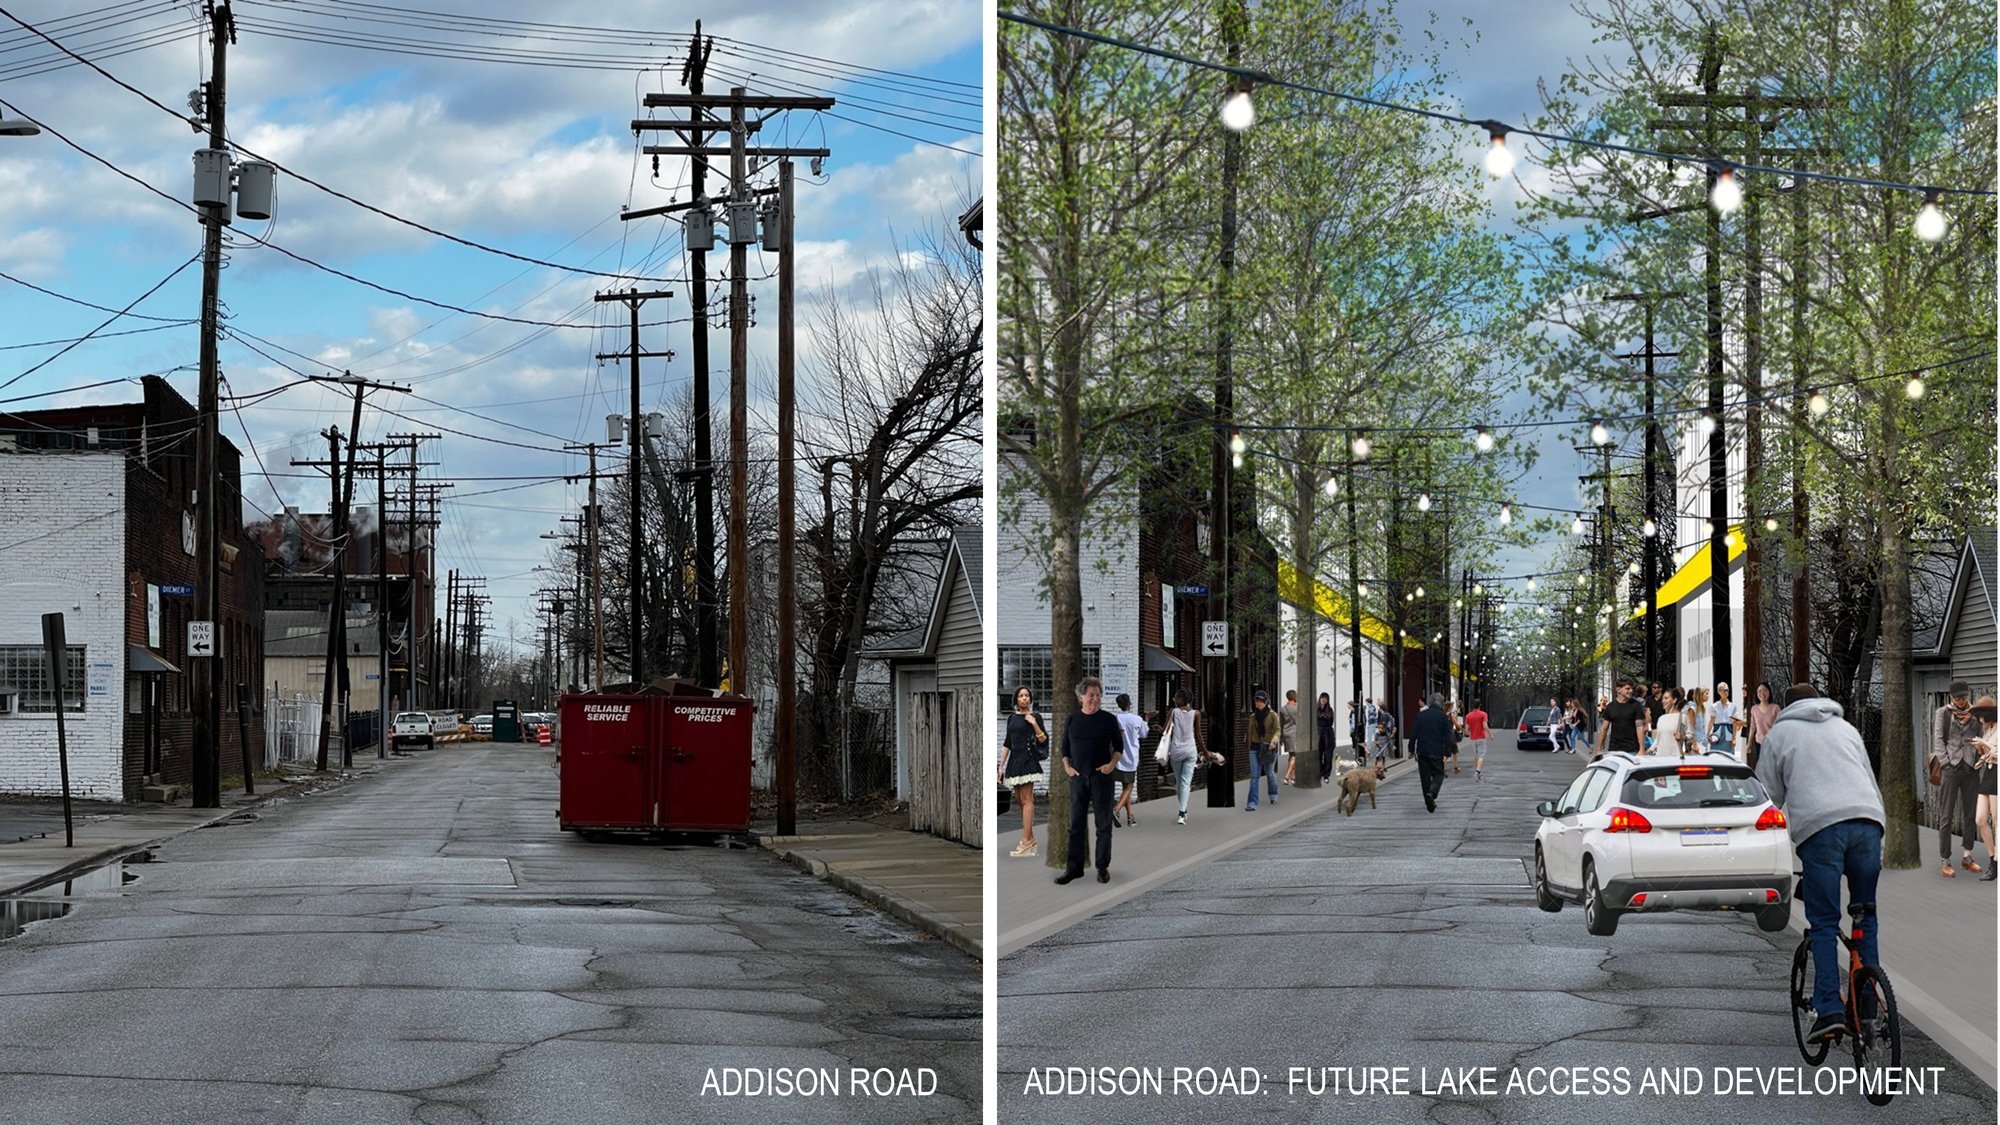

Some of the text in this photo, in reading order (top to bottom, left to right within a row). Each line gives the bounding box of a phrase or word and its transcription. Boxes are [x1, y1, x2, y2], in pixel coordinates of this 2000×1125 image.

[163, 586, 185, 594] DIEMER
[584, 705, 631, 713] RELIABLE
[674, 707, 737, 716] COMPETITIVE
[688, 714, 723, 722] PRICES
[436, 722, 457, 730] CLOSED
